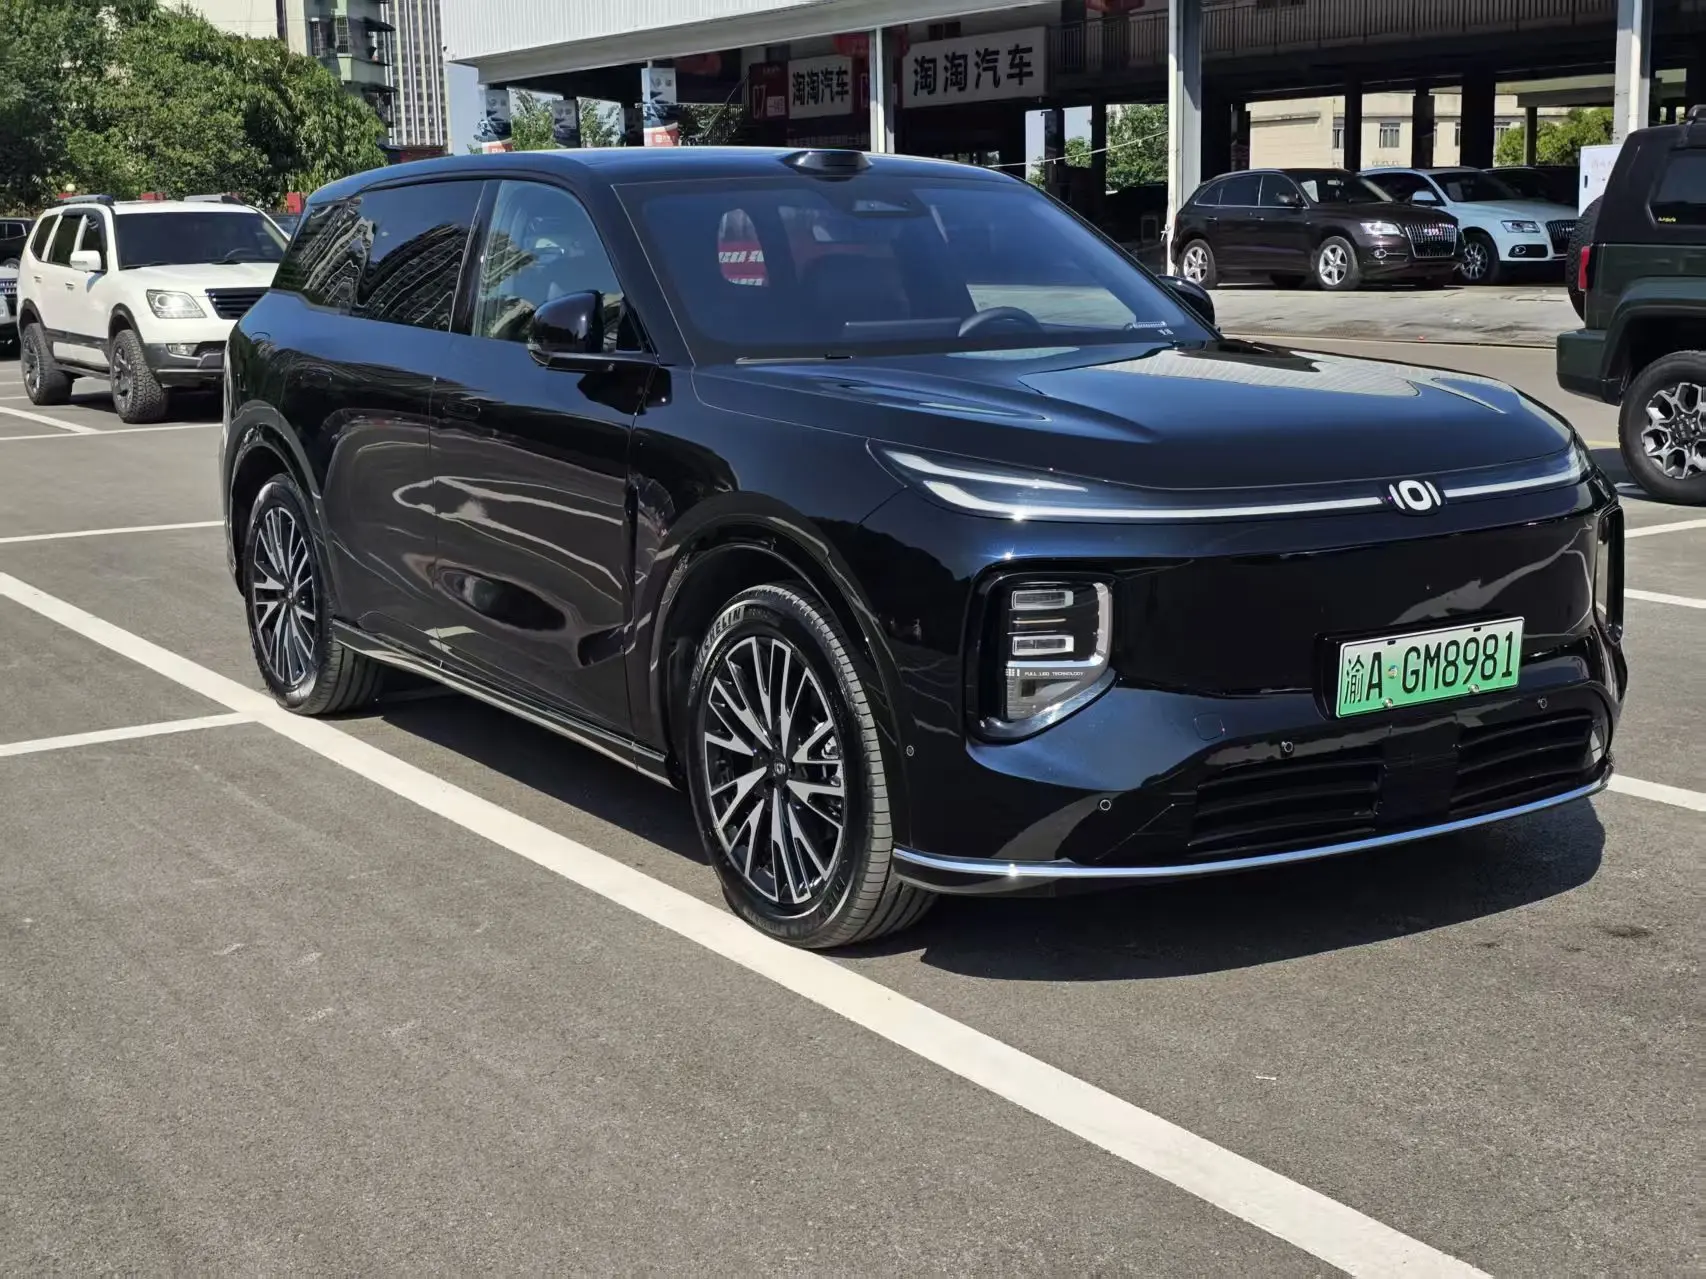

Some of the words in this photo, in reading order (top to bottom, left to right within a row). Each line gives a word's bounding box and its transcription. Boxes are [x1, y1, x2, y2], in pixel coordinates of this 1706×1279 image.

[792, 66, 849, 106] 淘淘汽车
[913, 43, 1034, 97] 淘淘汽车
